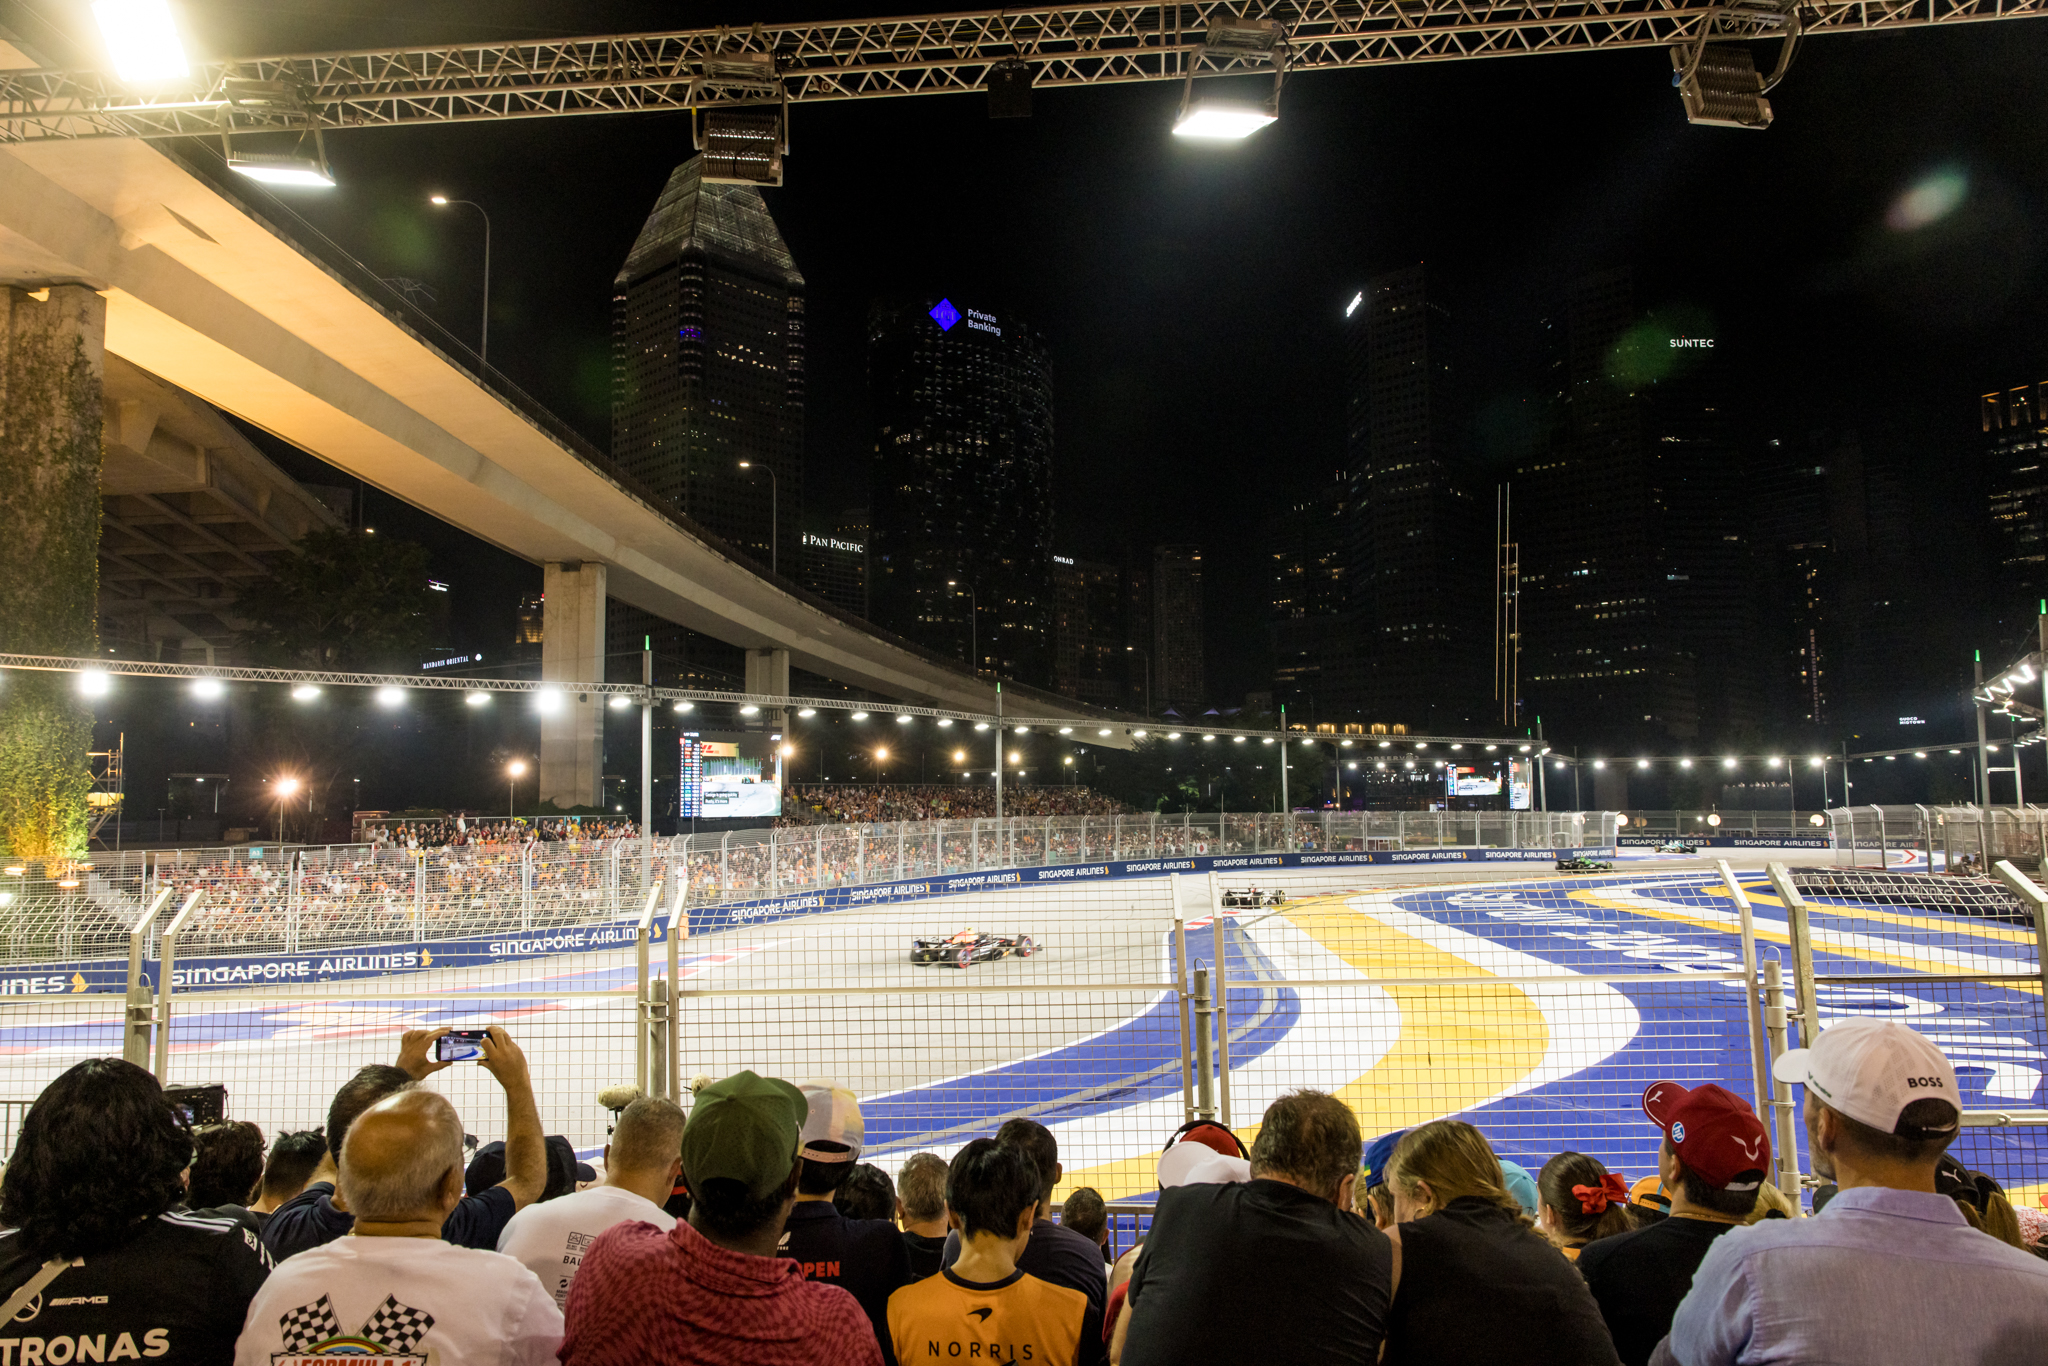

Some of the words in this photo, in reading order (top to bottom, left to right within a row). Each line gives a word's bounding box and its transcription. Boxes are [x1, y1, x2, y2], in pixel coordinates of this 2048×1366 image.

[967, 308, 997, 324] Private
[967, 319, 1002, 337] Banking
[1669, 338, 1715, 348] SUNTEC
[810, 534, 828, 547] PAN
[830, 538, 864, 553] PACIFIC
[446, 655, 469, 666] ORIENTAL
[1784, 839, 1822, 847] AIRLINES
[1212, 857, 1248, 868] SINGAPORE
[1249, 856, 1278, 866] AIRLINES
[1300, 855, 1337, 864] SINGAPORE
[1337, 854, 1368, 863] AIRLINES
[1391, 853, 1429, 861] SINGAPORE
[1431, 852, 1462, 860] AIRLINES
[1485, 850, 1520, 859] SINGAPORE
[1521, 851, 1552, 859] AIRLINES
[1038, 868, 1075, 880] SINGAPORE
[1075, 866, 1105, 877] AIRLINES
[1126, 862, 1161, 873] SINGAPORE
[1162, 861, 1191, 870] AIRLINES
[948, 875, 985, 889] SINGAPORE
[986, 873, 1016, 885] AIRLINES
[851, 886, 892, 902] SINGAPORE
[893, 883, 925, 896] AIRLINES
[1901, 883, 1953, 902] AIRLINES
[731, 902, 781, 922] SINGAPORE
[781, 897, 818, 913] AIRLINES
[489, 932, 585, 959] SINGAPORE
[171, 960, 310, 985] SINGAPORE
[317, 951, 417, 974] AIRLINES
[0, 975, 66, 996] INES
[1907, 1076, 1944, 1089] BOSS
[799, 1261, 841, 1278] PEN
[70, 1295, 109, 1305] AMG
[928, 1340, 1033, 1360] NORRIS
